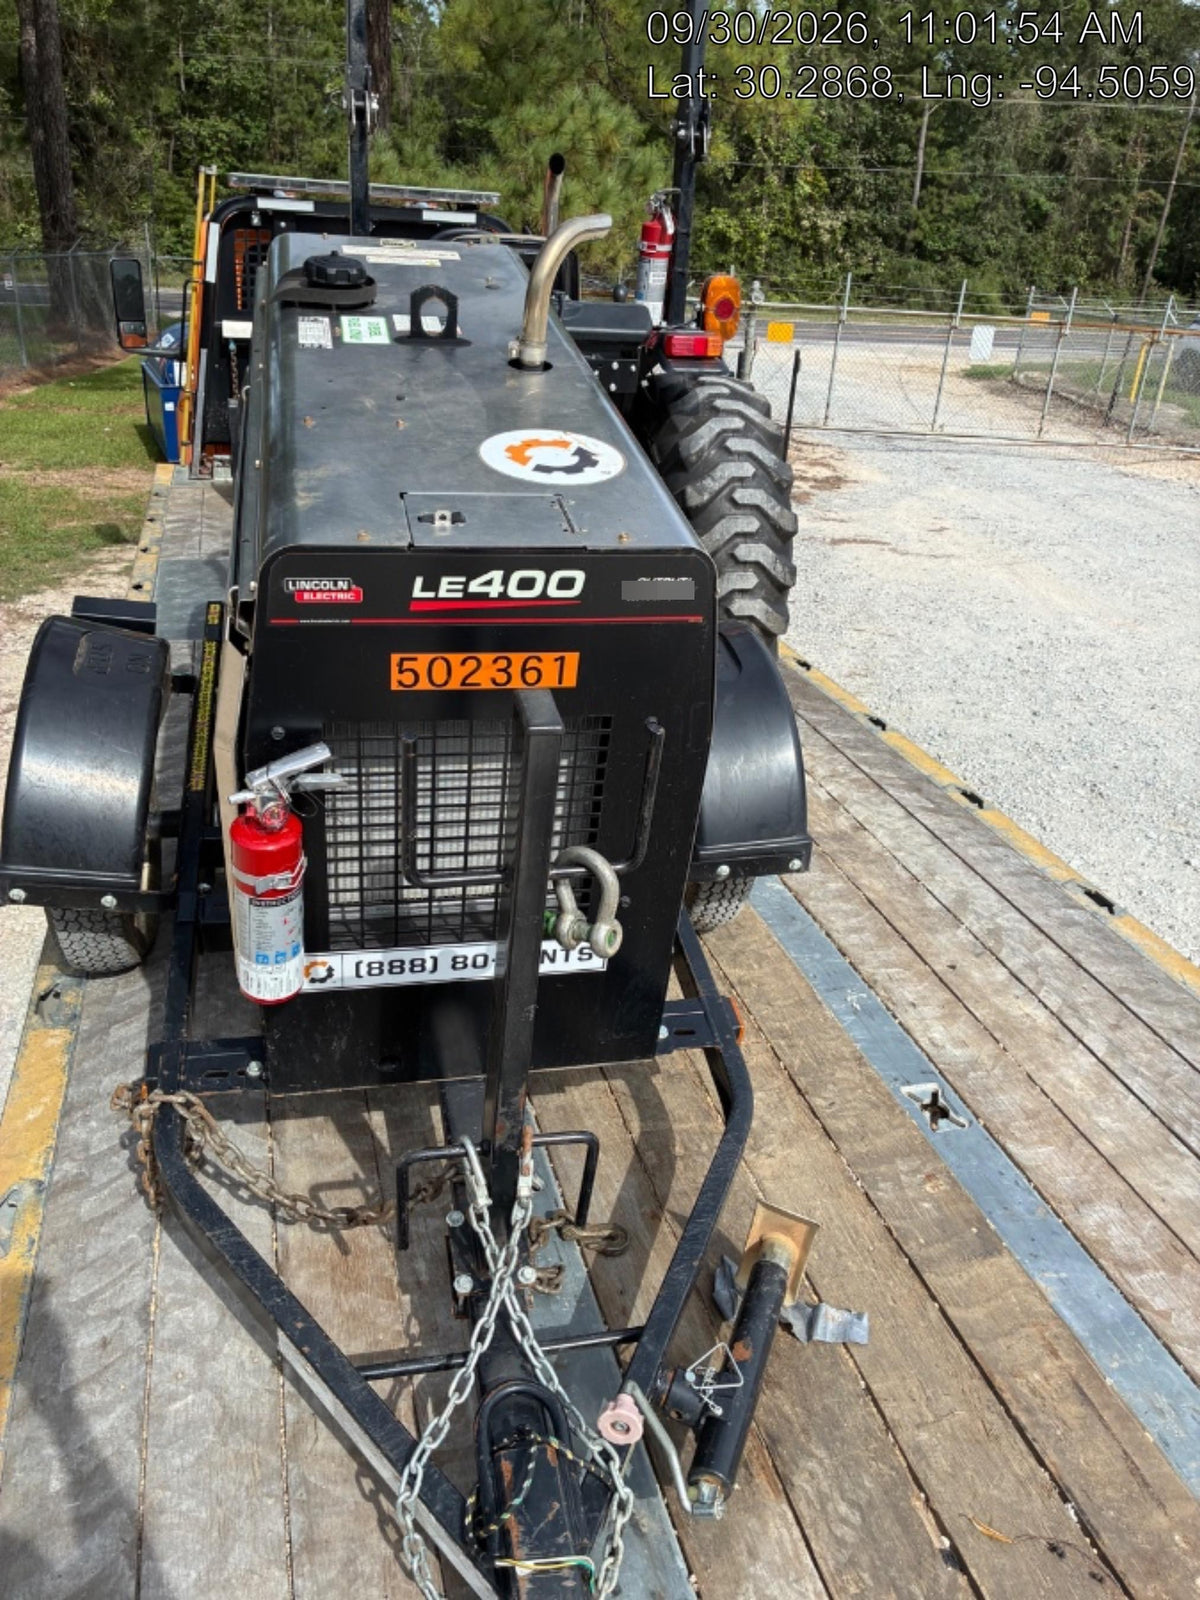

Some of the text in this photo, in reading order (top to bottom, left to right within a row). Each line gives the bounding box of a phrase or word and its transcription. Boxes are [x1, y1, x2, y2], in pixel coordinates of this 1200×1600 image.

[288, 580, 349, 591] LINCOLN
[411, 569, 586, 599] LE400
[303, 592, 356, 600] ELECTRIC
[396, 654, 567, 689] 502361
[355, 956, 438, 978] (888)
